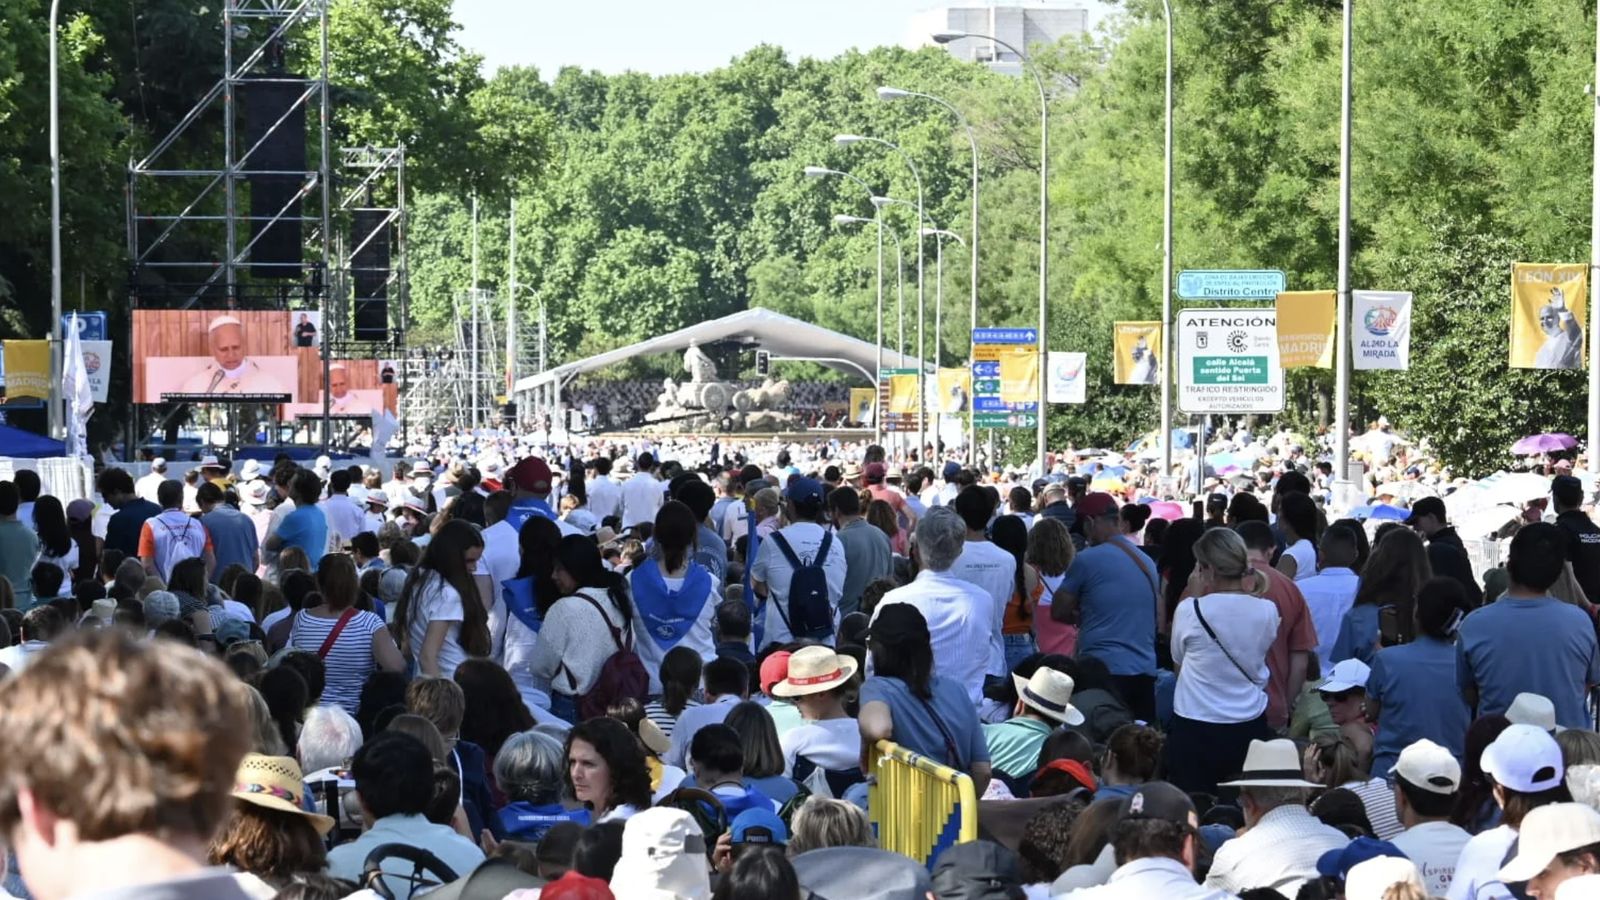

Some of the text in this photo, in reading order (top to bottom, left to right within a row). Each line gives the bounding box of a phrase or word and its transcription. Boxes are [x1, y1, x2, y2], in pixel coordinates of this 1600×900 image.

[1203, 287, 1279, 296] Distrito Centro
[1186, 316, 1276, 327] ATENCIÓN
[1388, 340, 1399, 348] LA
[1362, 349, 1396, 359] MIRADA
[1216, 374, 1245, 382] del Sol
[1222, 385, 1278, 393] RESTRINGIDO
